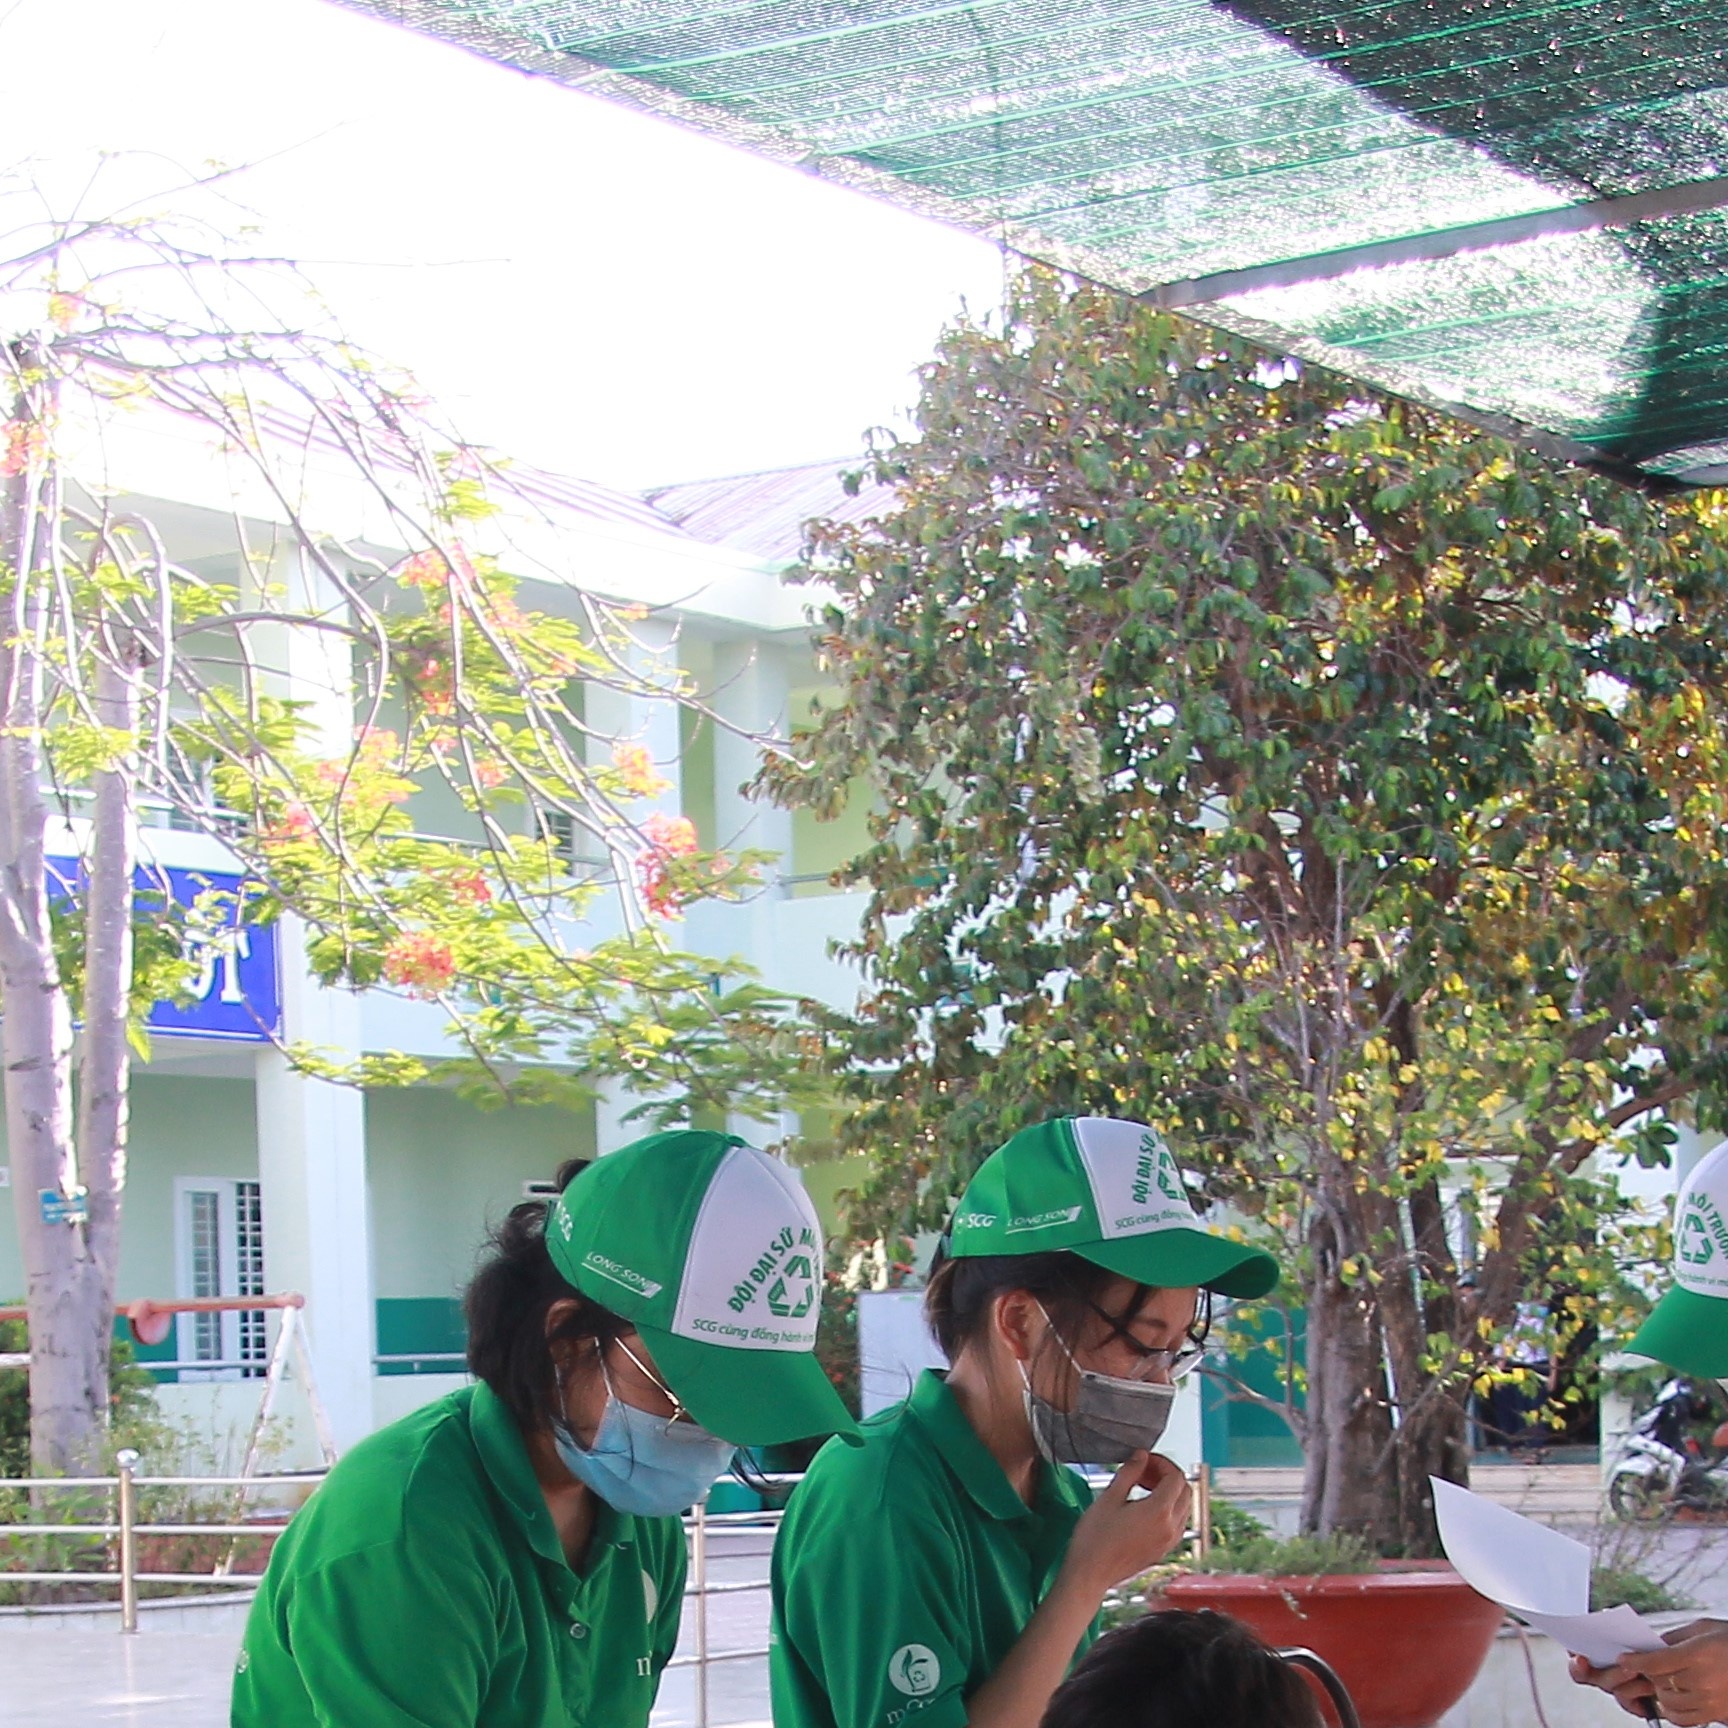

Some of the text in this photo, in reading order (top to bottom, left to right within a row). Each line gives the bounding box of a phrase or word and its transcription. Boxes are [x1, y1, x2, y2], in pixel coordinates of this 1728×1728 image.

[966, 1213, 997, 1228] SCG
[1007, 1212, 1043, 1227] LONG
[586, 1251, 623, 1275] LONG
[727, 1226, 794, 1314] ĐỘI ĐẠI SỨ
[692, 1318, 717, 1334] SCG
[718, 1323, 749, 1341] cùng
[750, 1324, 780, 1343] đồng
